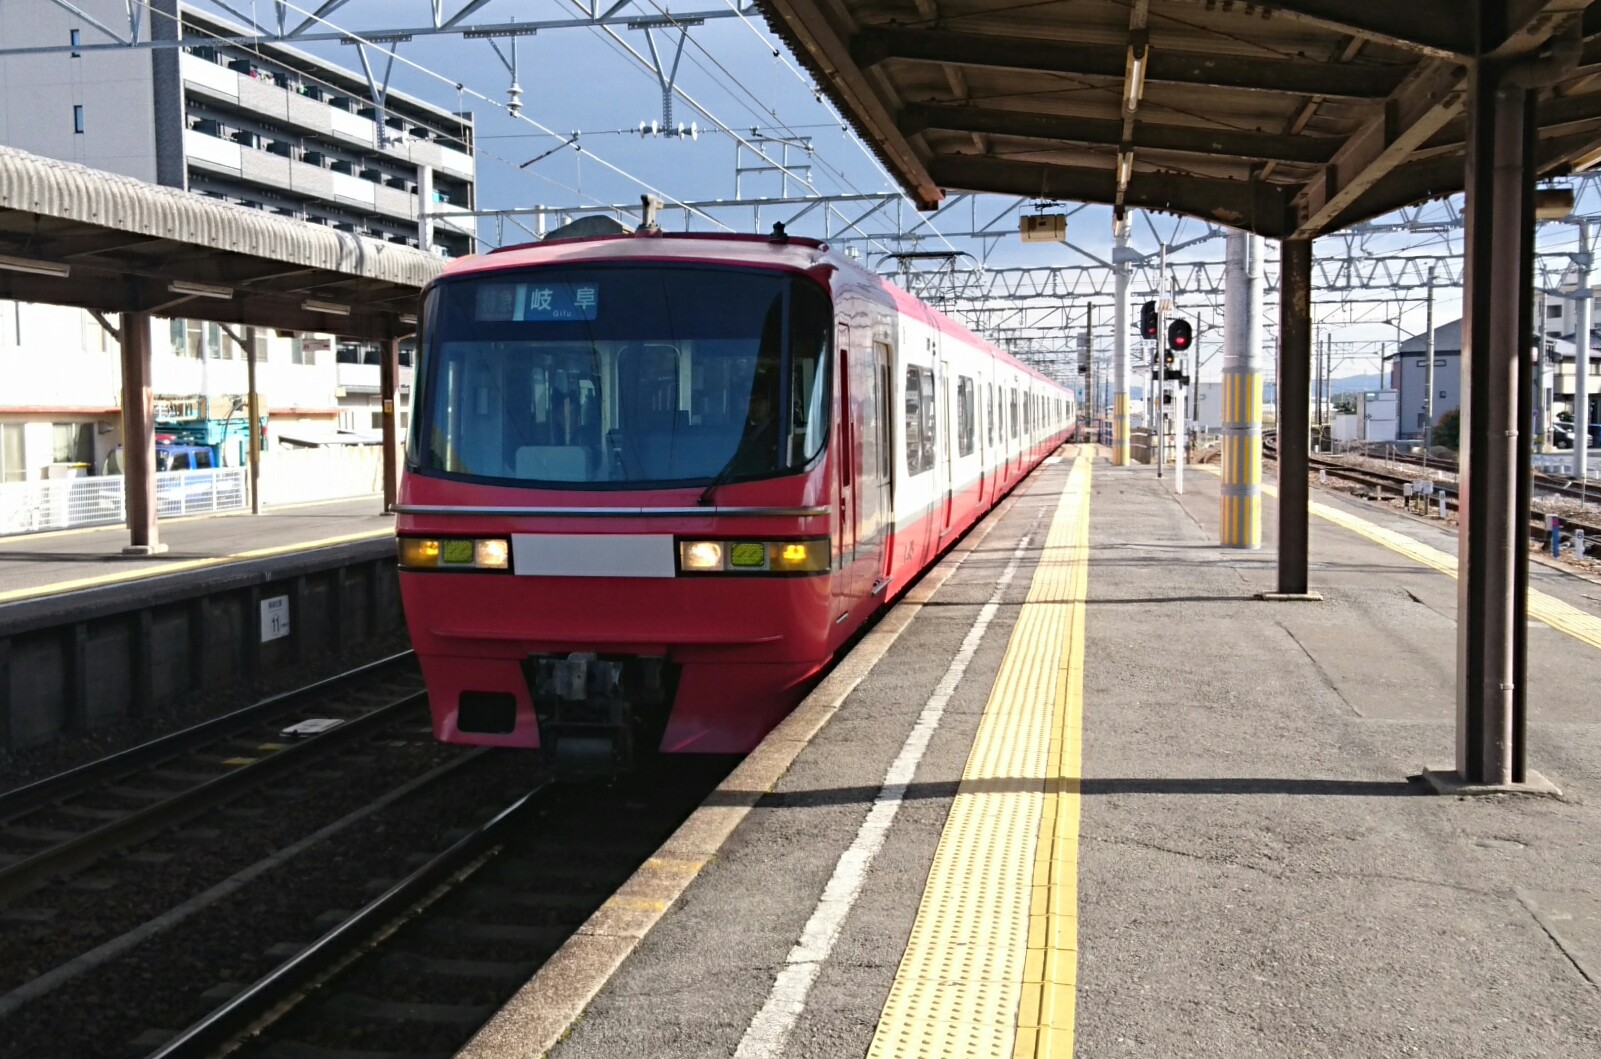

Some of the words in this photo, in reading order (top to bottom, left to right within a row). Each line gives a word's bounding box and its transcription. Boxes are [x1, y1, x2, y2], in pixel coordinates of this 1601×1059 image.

[531, 287, 595, 311] 岐阜
[553, 310, 571, 318] Gifu
[272, 616, 280, 632] 11
